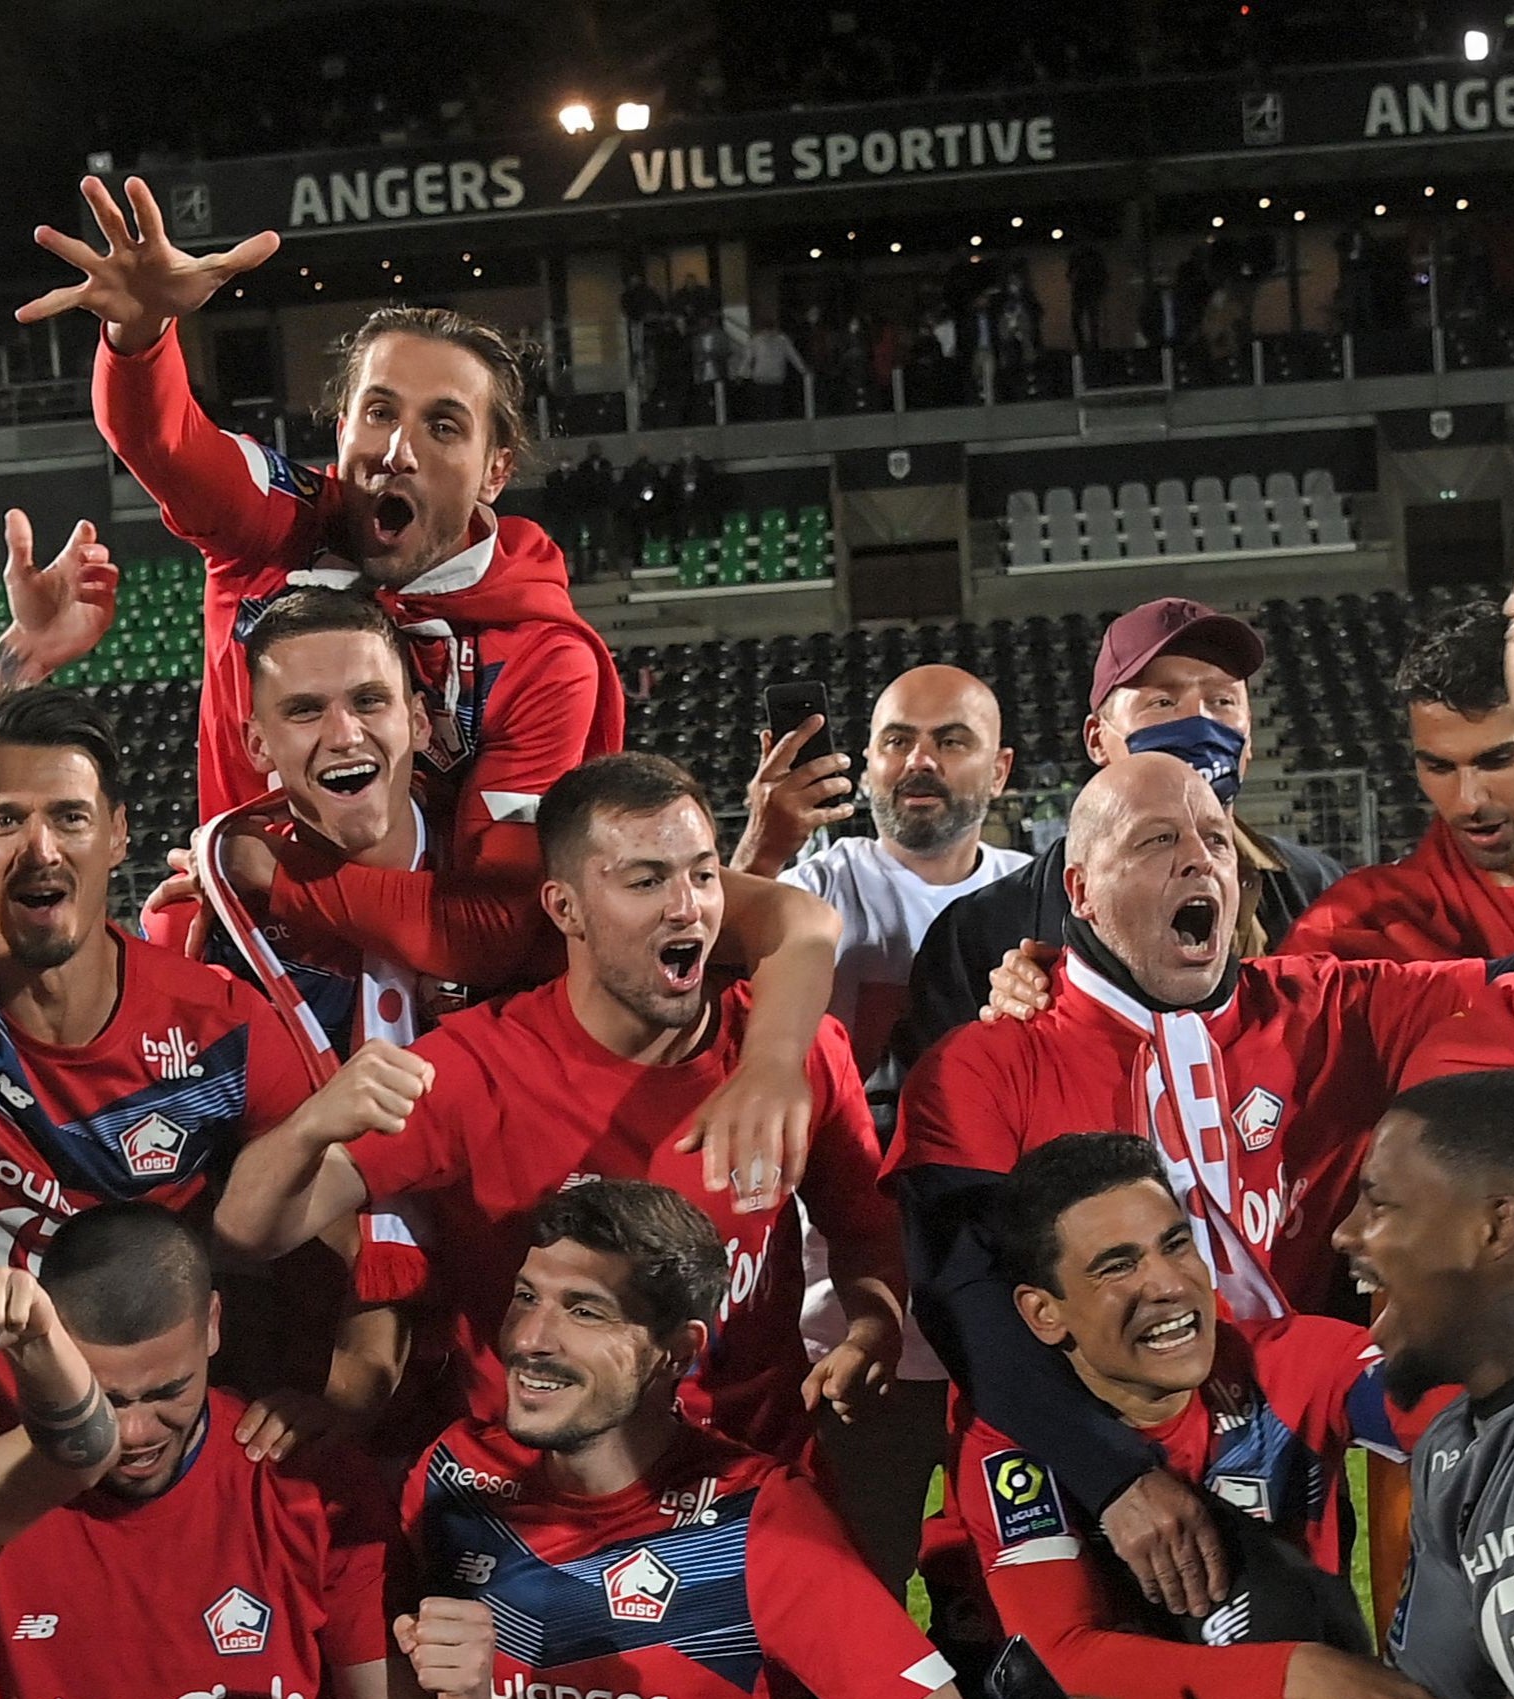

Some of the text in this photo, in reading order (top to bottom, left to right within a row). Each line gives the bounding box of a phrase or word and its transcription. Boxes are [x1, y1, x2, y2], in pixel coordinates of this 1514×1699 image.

[290, 116, 1056, 228] ANGERS VILLE SPORTIVE
[136, 1159, 172, 1171] LOSC
[437, 1461, 522, 1500] neosat
[1043, 1504, 1051, 1513] 1
[616, 1602, 658, 1618] LOSC
[222, 1636, 258, 1650] LOSC
